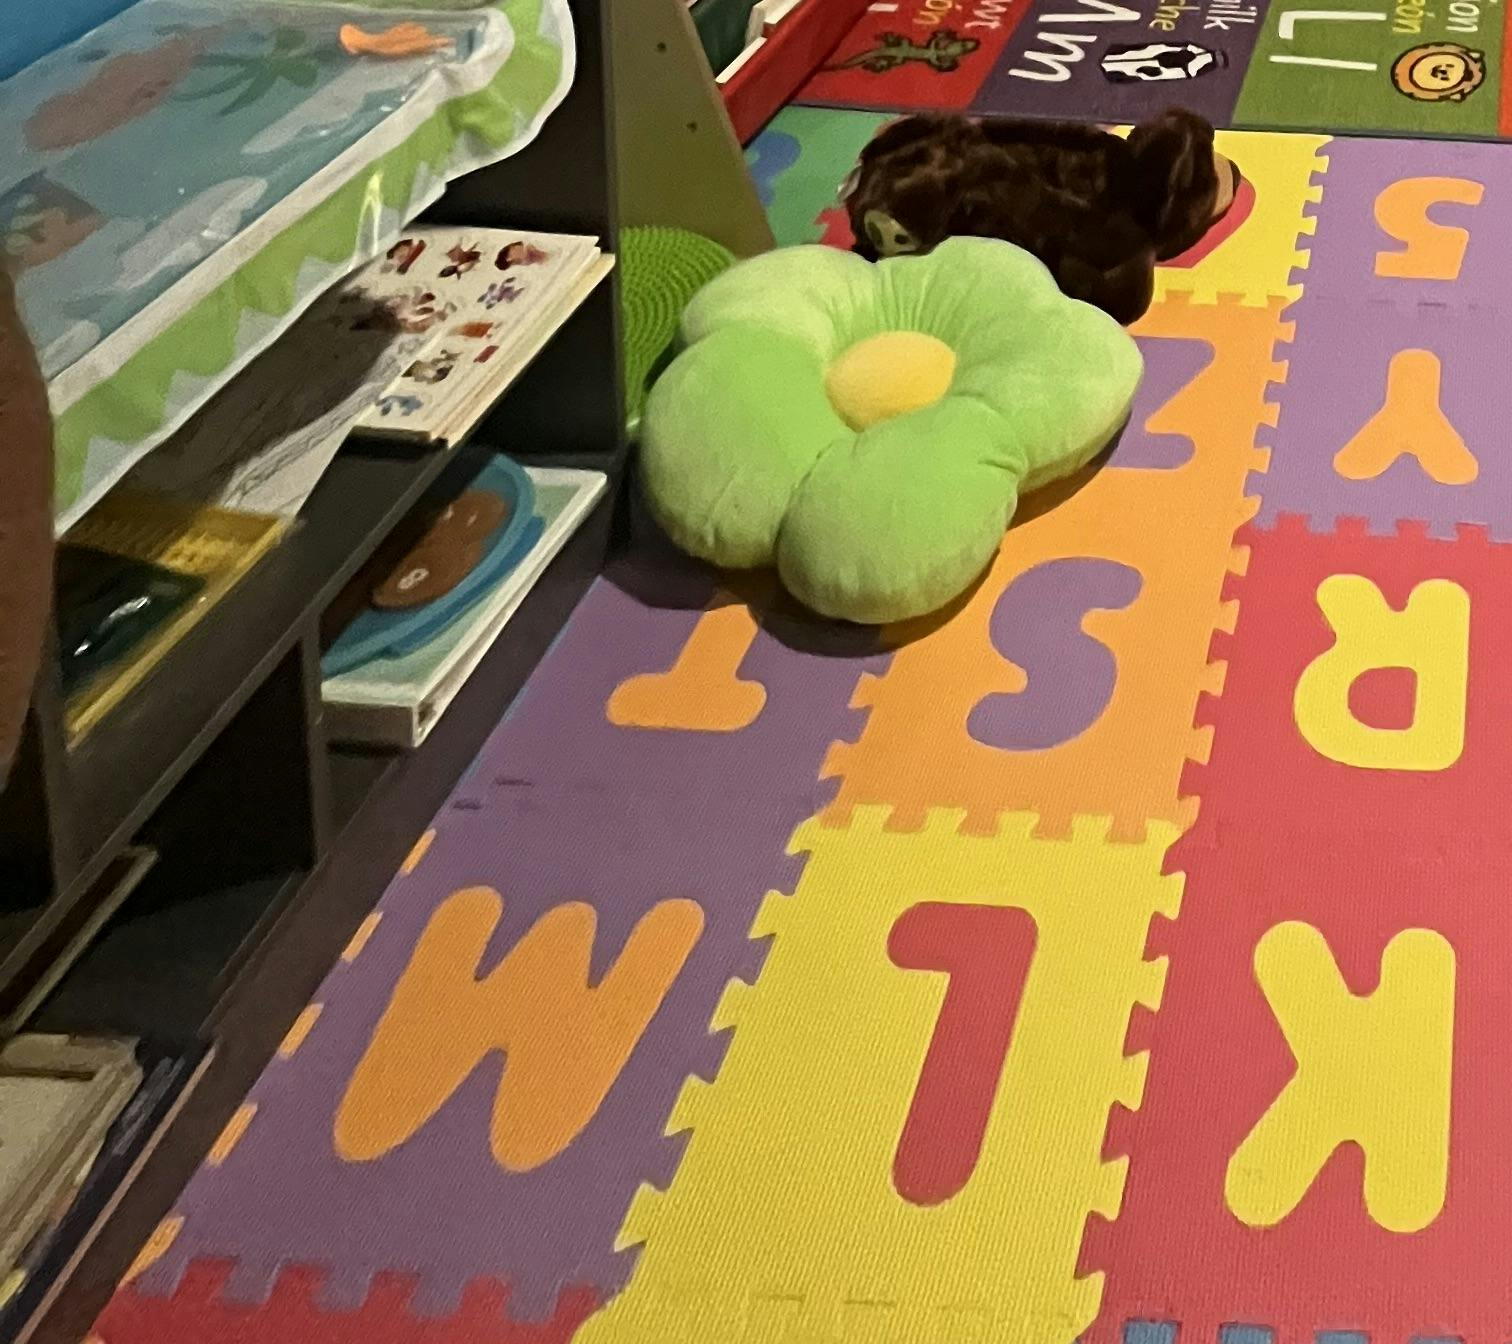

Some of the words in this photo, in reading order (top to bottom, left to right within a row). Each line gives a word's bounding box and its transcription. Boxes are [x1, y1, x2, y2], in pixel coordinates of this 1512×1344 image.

[1373, 176, 1485, 281] 5
[1332, 348, 1480, 485] Y
[607, 602, 767, 732] T
[966, 555, 1145, 752] S
[1293, 573, 1472, 772] R
[333, 884, 706, 1173] M
[886, 901, 1040, 1208] L
[1224, 919, 1457, 1233] K
